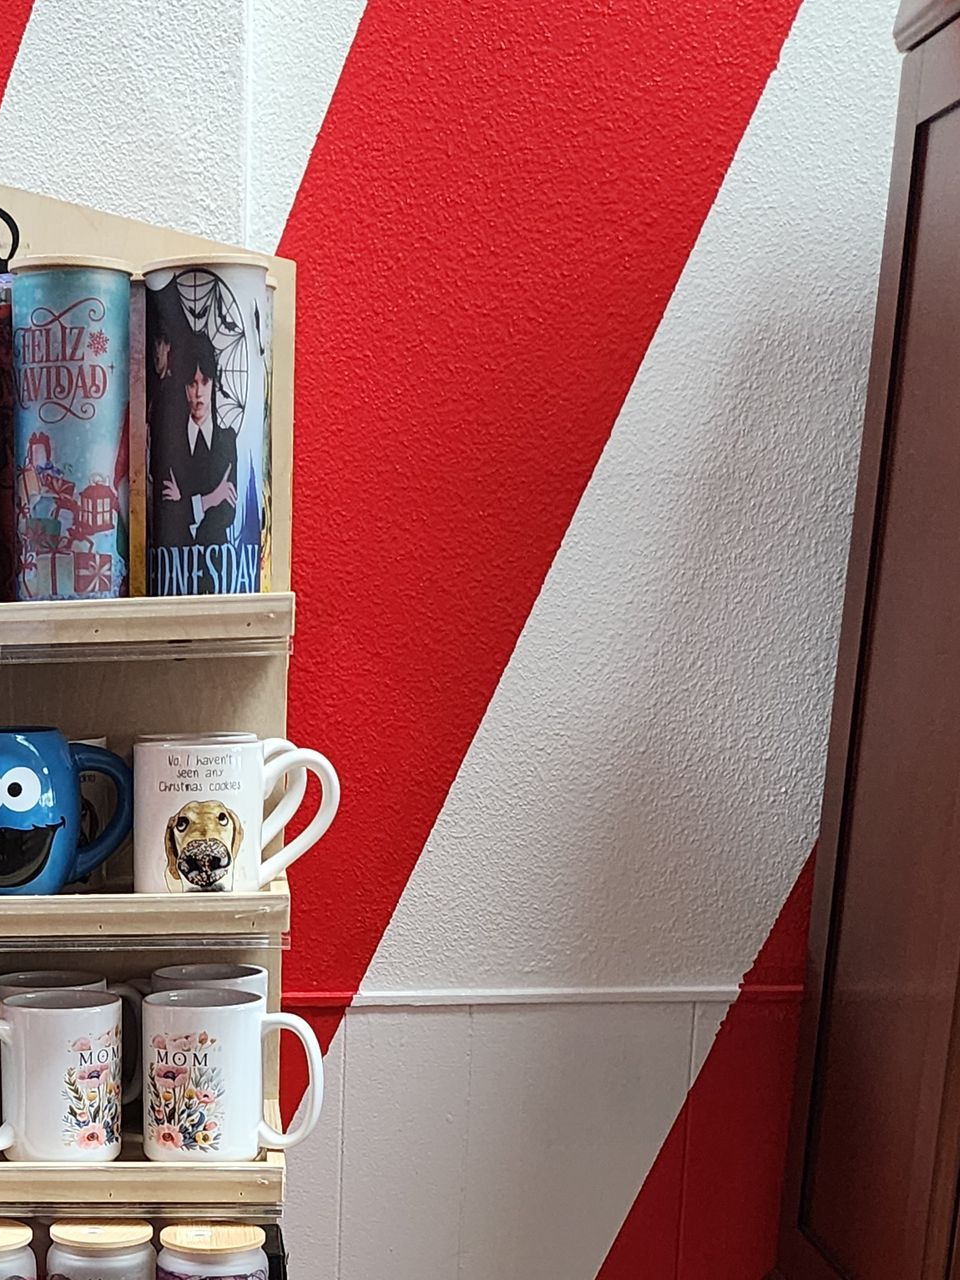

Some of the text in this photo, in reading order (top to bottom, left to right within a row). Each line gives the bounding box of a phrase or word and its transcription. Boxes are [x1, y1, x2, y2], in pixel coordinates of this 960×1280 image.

[14, 324, 86, 365] FELIZ
[196, 754, 233, 767] haven't
[176, 768, 224, 779] seen any
[159, 780, 241, 793] Christmas cookies
[156, 1049, 209, 1067] MOM
